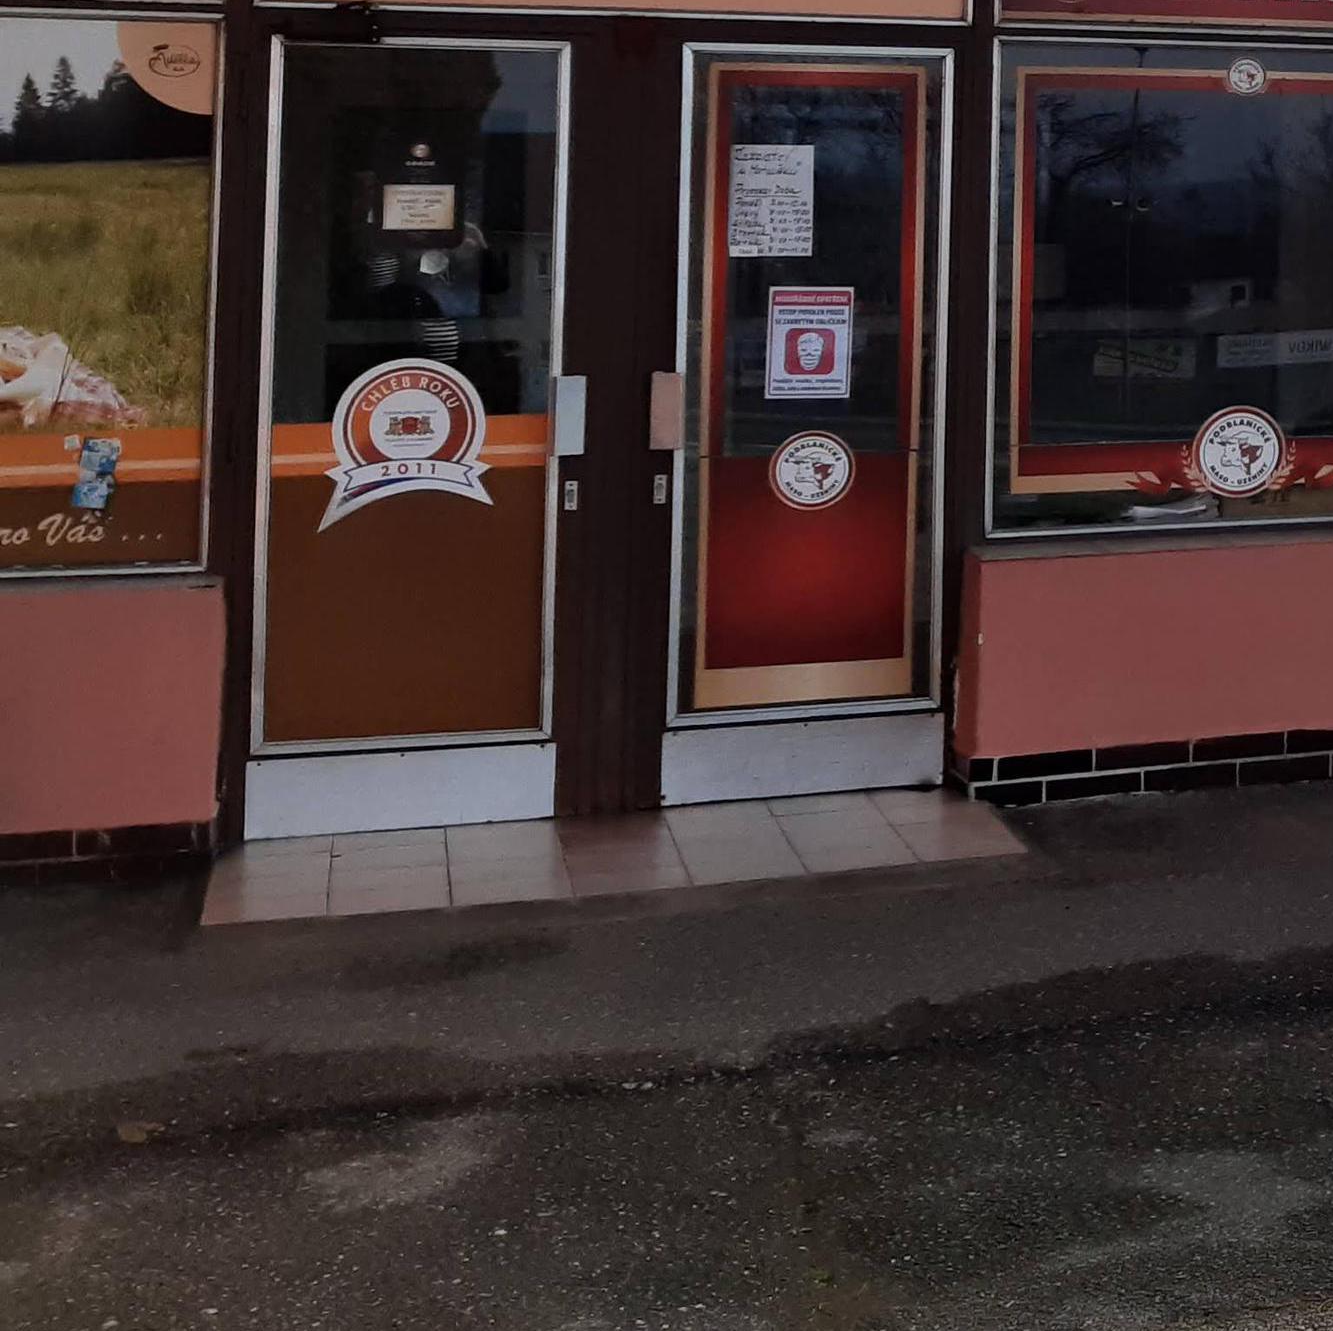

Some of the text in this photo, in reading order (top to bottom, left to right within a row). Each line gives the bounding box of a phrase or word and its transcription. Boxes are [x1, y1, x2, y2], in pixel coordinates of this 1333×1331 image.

[418, 377, 460, 408] ROKU
[381, 463, 437, 477] 2011
[0, 527, 30, 545] ro
